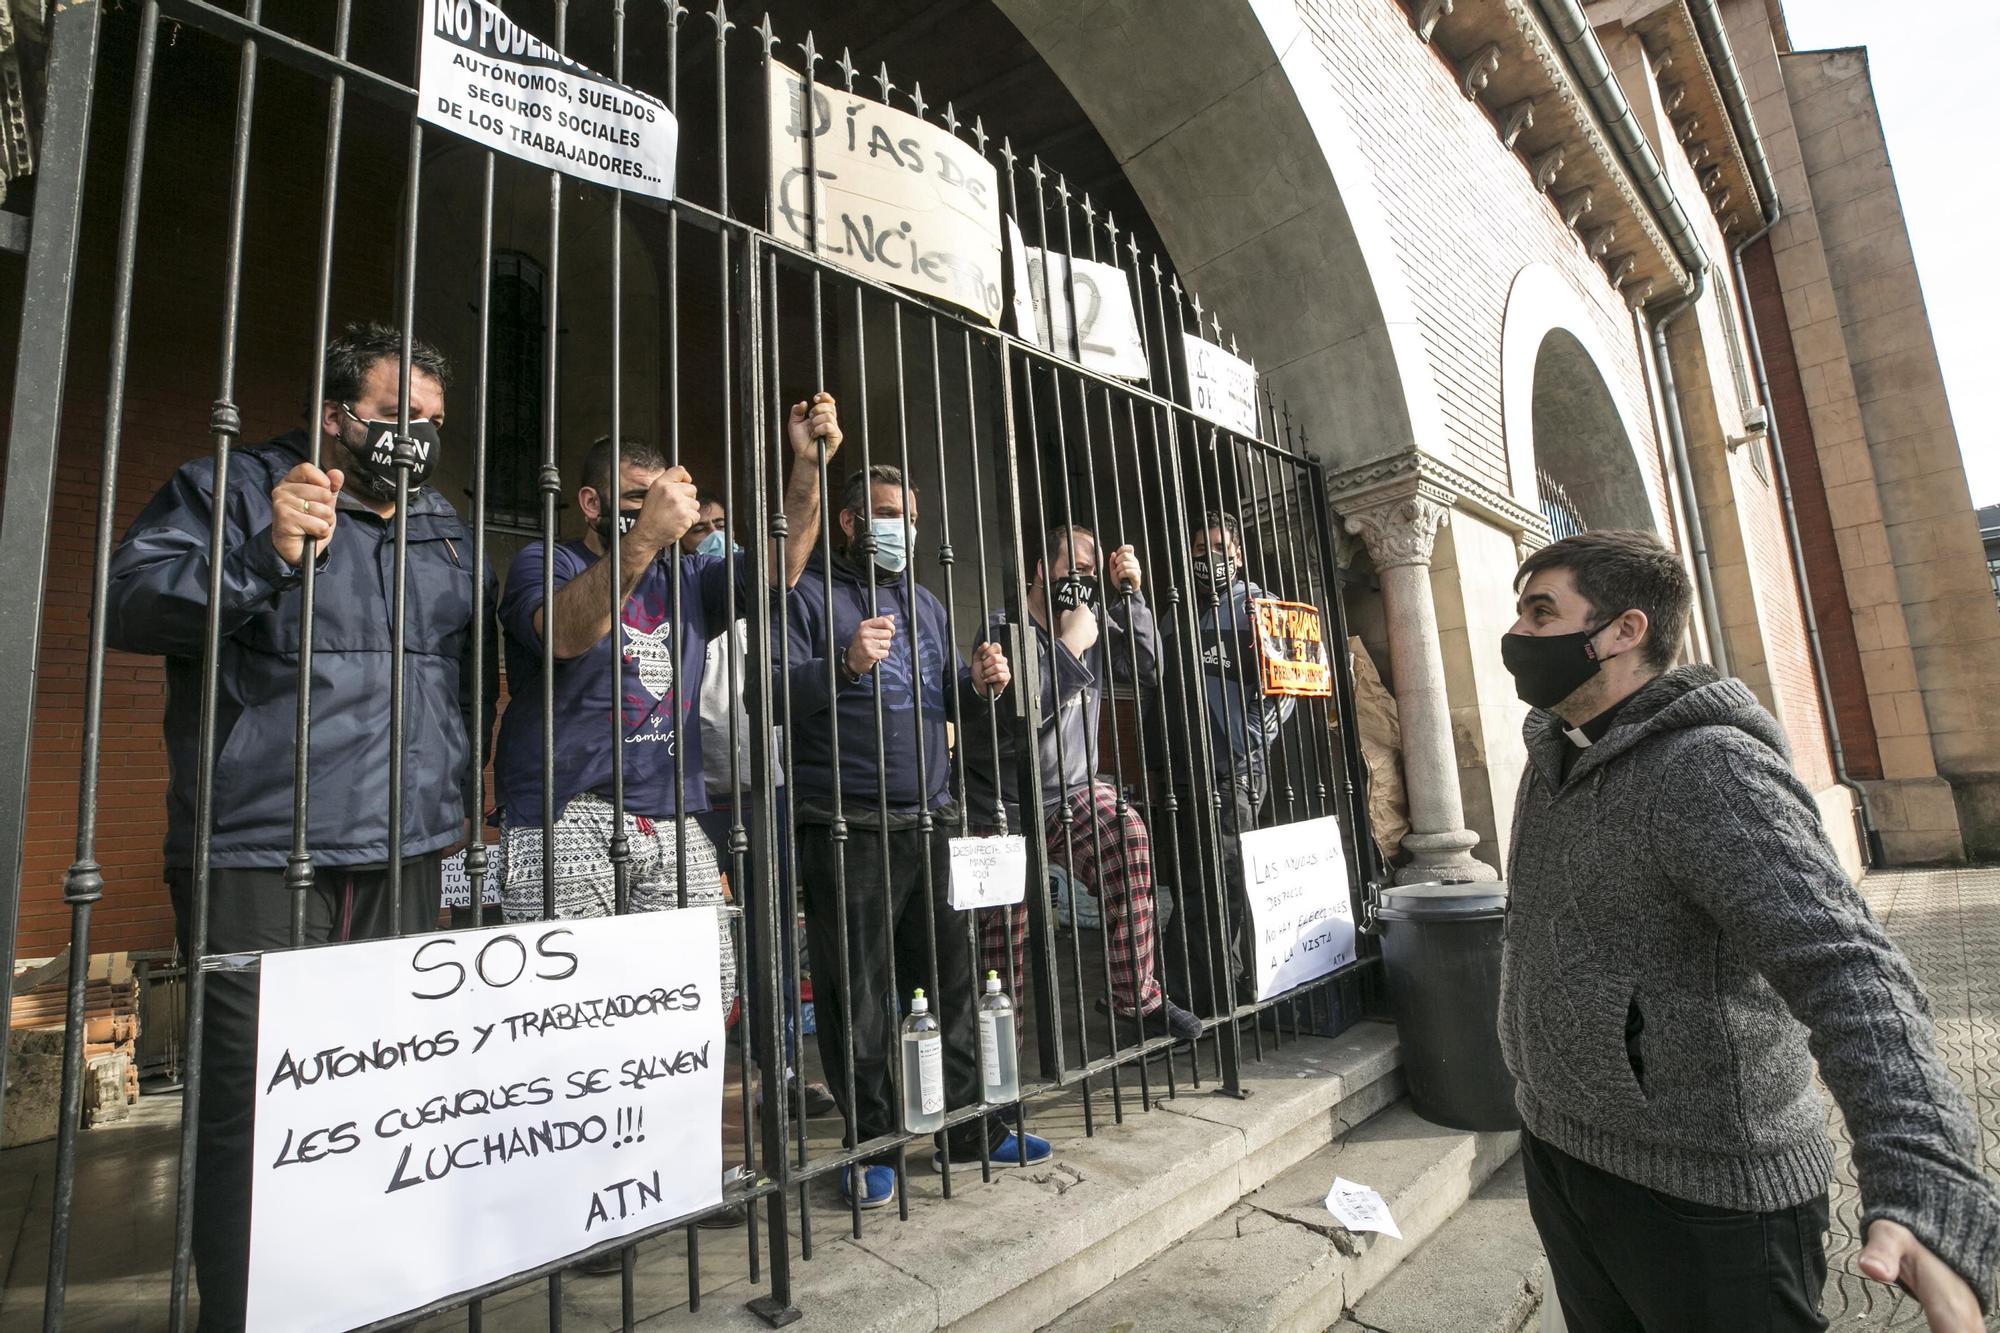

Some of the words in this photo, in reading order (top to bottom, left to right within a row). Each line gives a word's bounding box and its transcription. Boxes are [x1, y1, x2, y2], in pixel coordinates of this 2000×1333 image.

[437, 0, 473, 41] NO
[452, 52, 572, 104] AUTÓNOMOS,
[578, 87, 656, 124] SUELDOS
[437, 97, 462, 120] DE
[468, 109, 504, 136] LOS
[467, 83, 553, 122] SEGUROS
[558, 111, 640, 149] SOCIALES
[446, 873, 460, 882] TU
[1252, 854, 1279, 884] LAS
[1270, 955, 1278, 970] A
[1283, 945, 1294, 964] LA
[1302, 931, 1332, 952] VISTA
[266, 1029, 460, 1095] AUTONOMOS
[501, 983, 702, 1042] TRABAJADORES
[272, 1121, 361, 1170] LES
[375, 1077, 554, 1139] CUENQUES
[566, 1068, 613, 1100] SE
[619, 1040, 711, 1090] SALVEN
